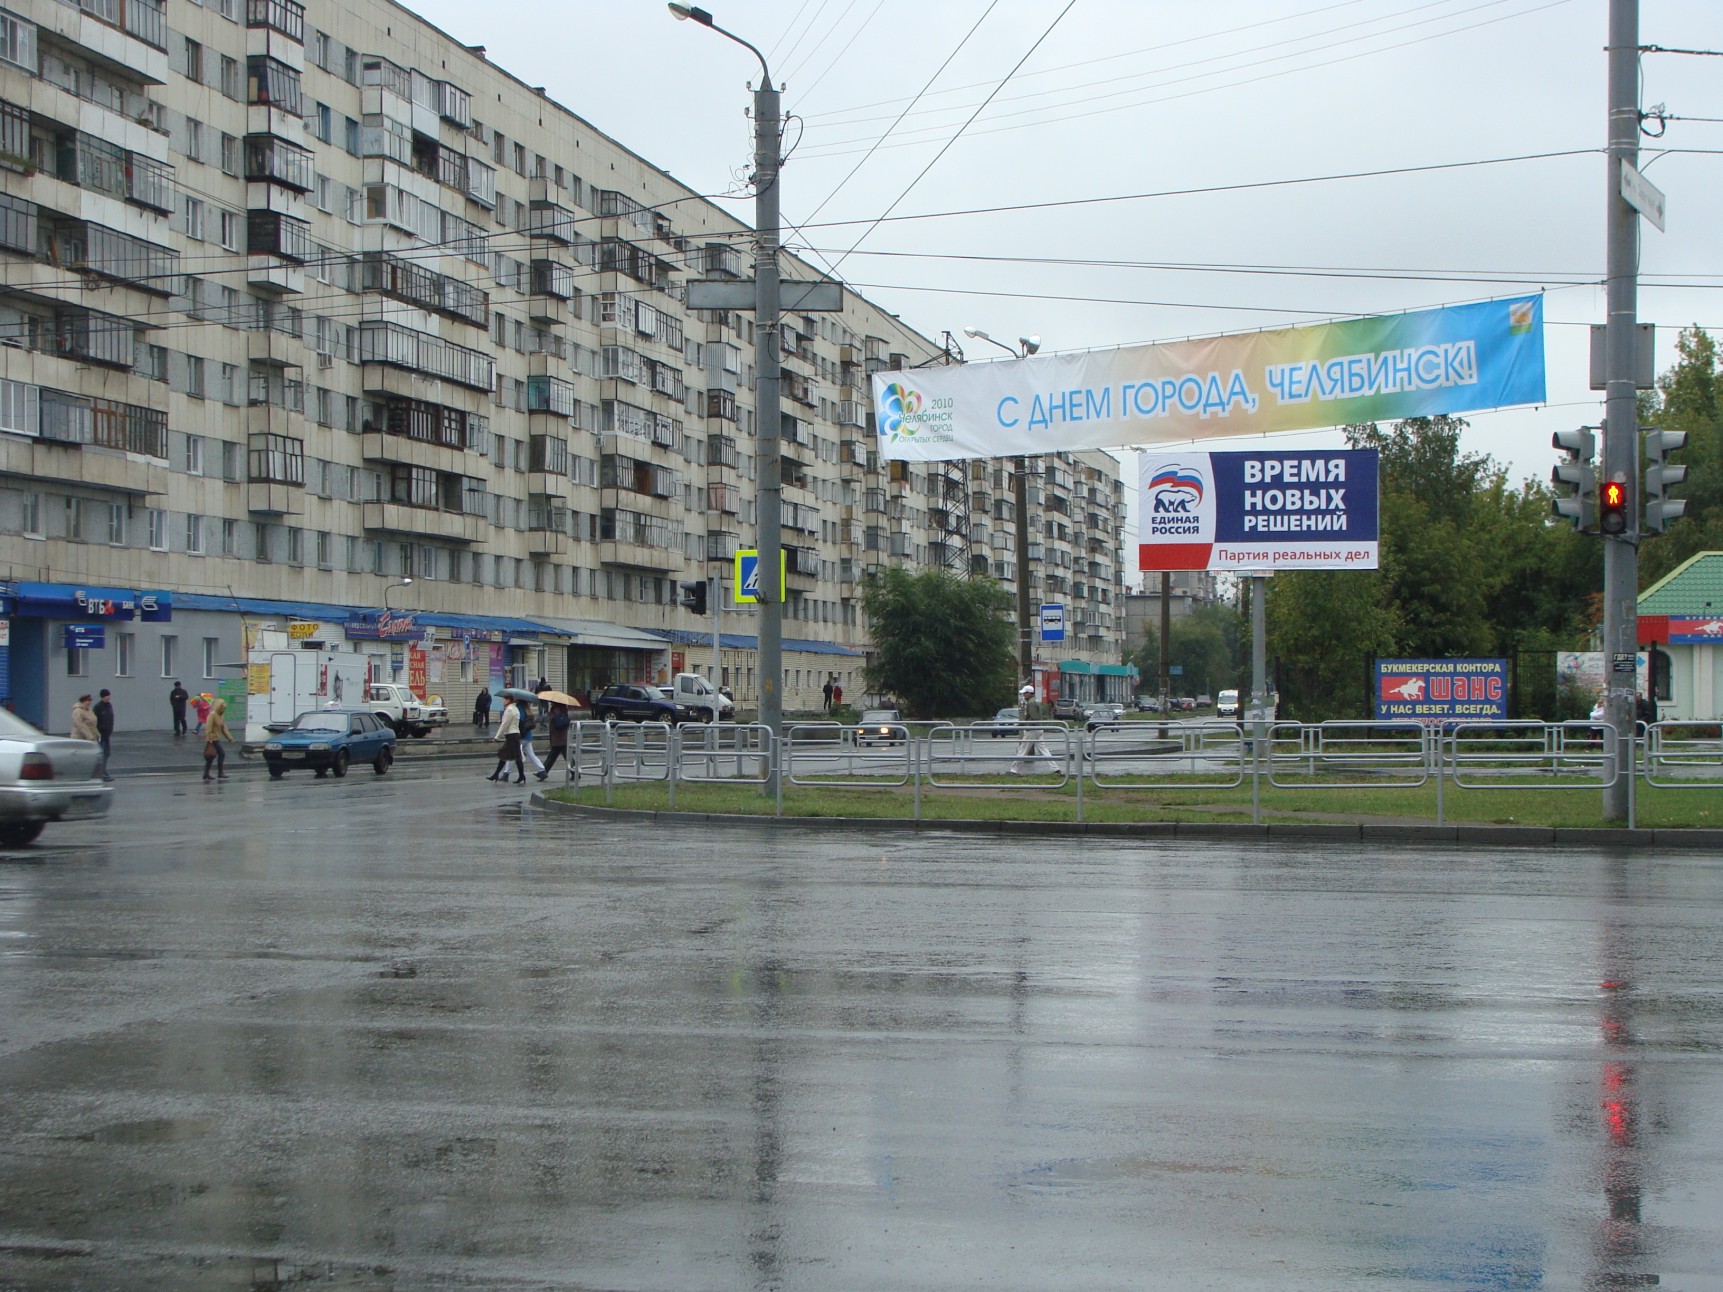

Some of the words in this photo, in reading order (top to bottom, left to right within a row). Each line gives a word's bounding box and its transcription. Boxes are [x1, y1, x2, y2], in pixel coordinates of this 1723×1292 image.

[997, 396, 1019, 427] С
[1028, 386, 1111, 431] ДНЕМ
[1122, 372, 1257, 416] ГОРОДА,
[1267, 344, 1474, 401] ЧЕЛЯБИНСК!
[931, 398, 953, 409] 2010
[898, 409, 953, 423] Челябинск
[930, 424, 953, 433] ГОРОД
[1244, 459, 1346, 483] ВРЕМЯ
[1244, 489, 1346, 511] НОВЫХ
[1151, 515, 1199, 525] ЕДИНАЯ
[1244, 511, 1347, 531] РЕШЕНИЙ
[1151, 525, 1200, 535] РОССИЯ
[1218, 549, 1269, 563] Партия
[1273, 549, 1341, 563] реальных
[1345, 550, 1370, 561] дел
[88, 599, 115, 614] ВТБ24
[290, 623, 319, 631] ФОТО
[1381, 663, 1454, 673] БУКМЕКЕРСКАЯ
[1456, 663, 1501, 673] КОНТОРА
[1381, 705, 1388, 714] У
[1390, 704, 1413, 714] НАС
[1415, 704, 1452, 714] ВЕЗЕТ.
[1455, 704, 1501, 715] ВСЕГДА.
